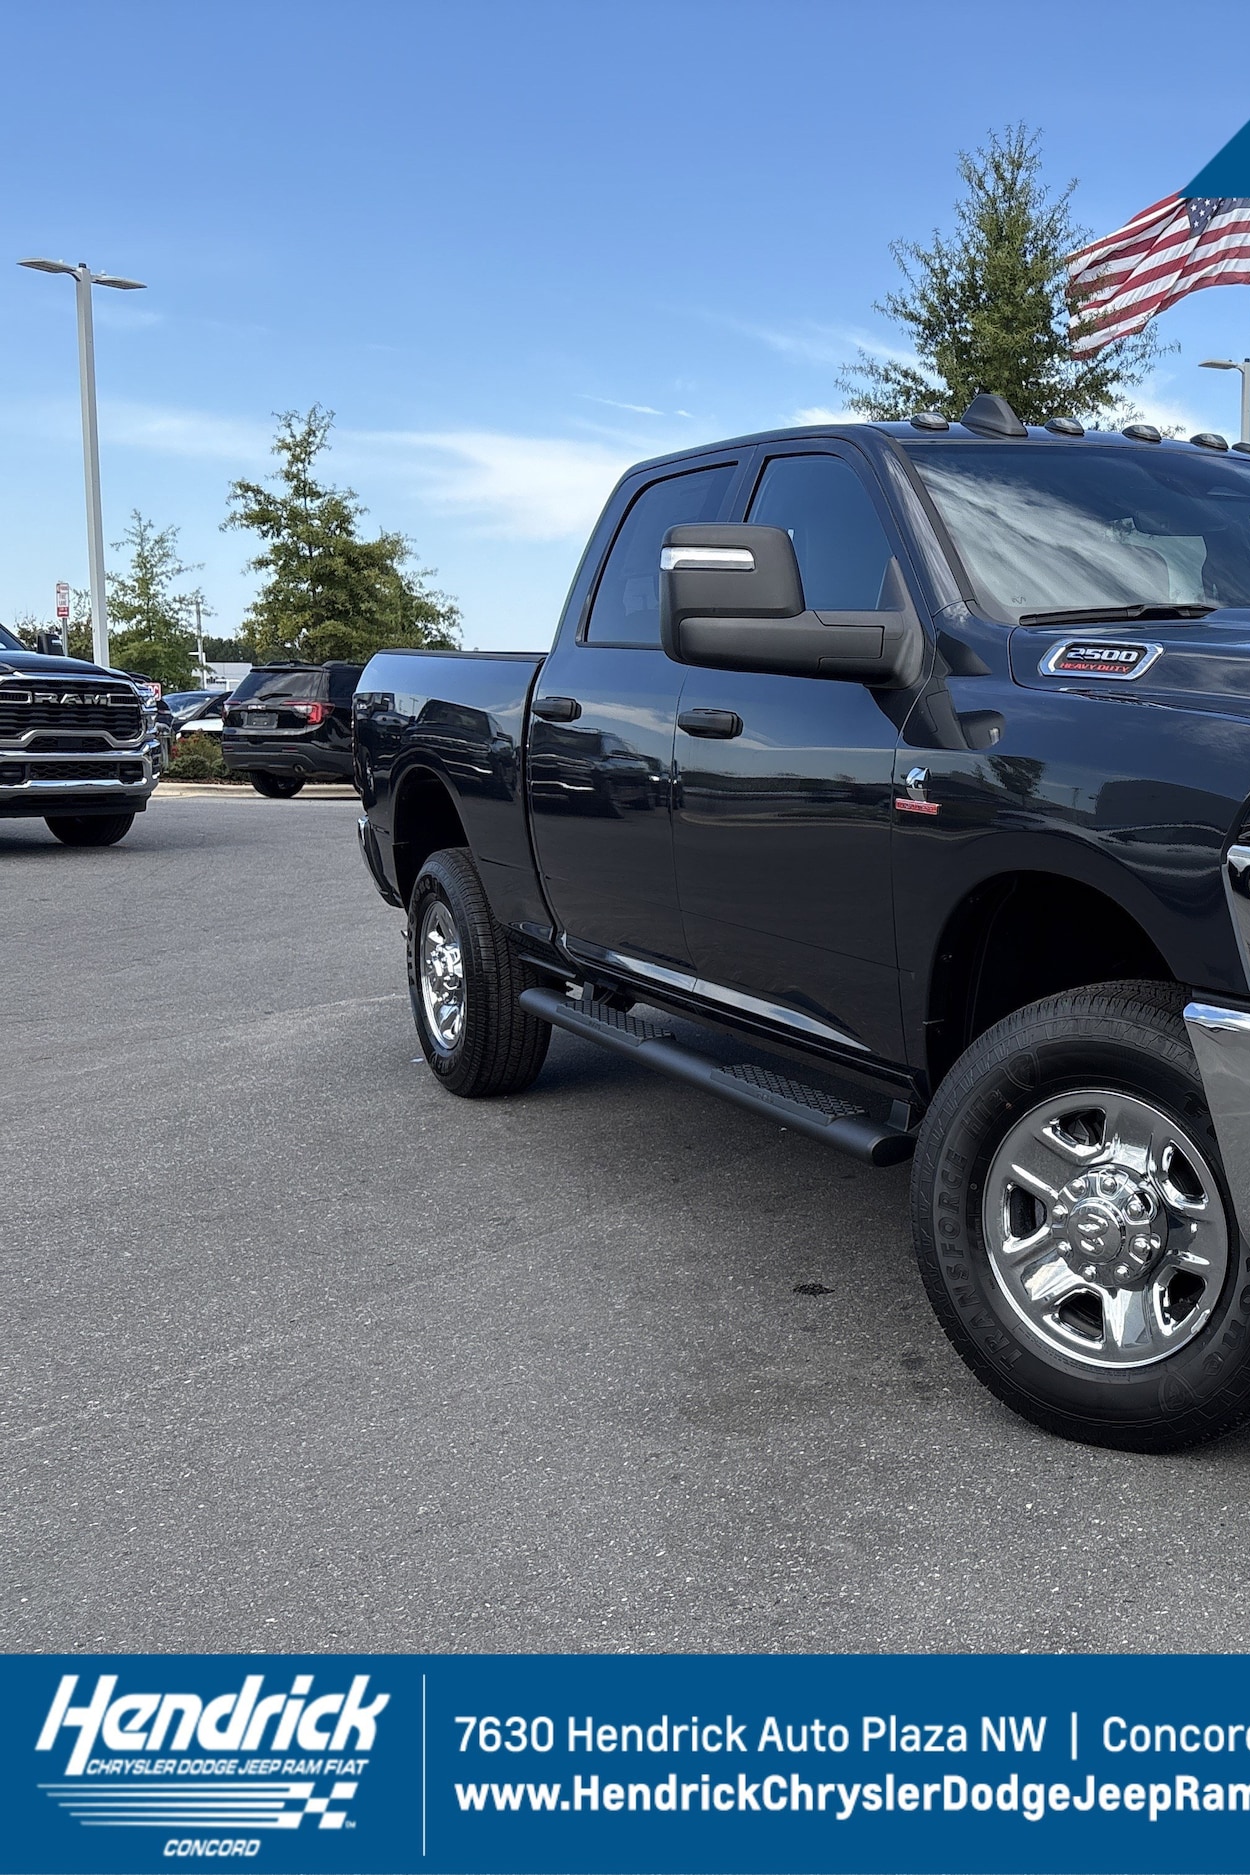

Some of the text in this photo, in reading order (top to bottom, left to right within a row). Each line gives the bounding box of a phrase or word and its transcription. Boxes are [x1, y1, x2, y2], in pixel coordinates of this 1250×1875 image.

[1066, 647, 1139, 663] 2500
[1060, 662, 1130, 673] HEAVY DUTY
[34, 692, 107, 705] RAM
[938, 1148, 1023, 1372] TRANSFORCE
